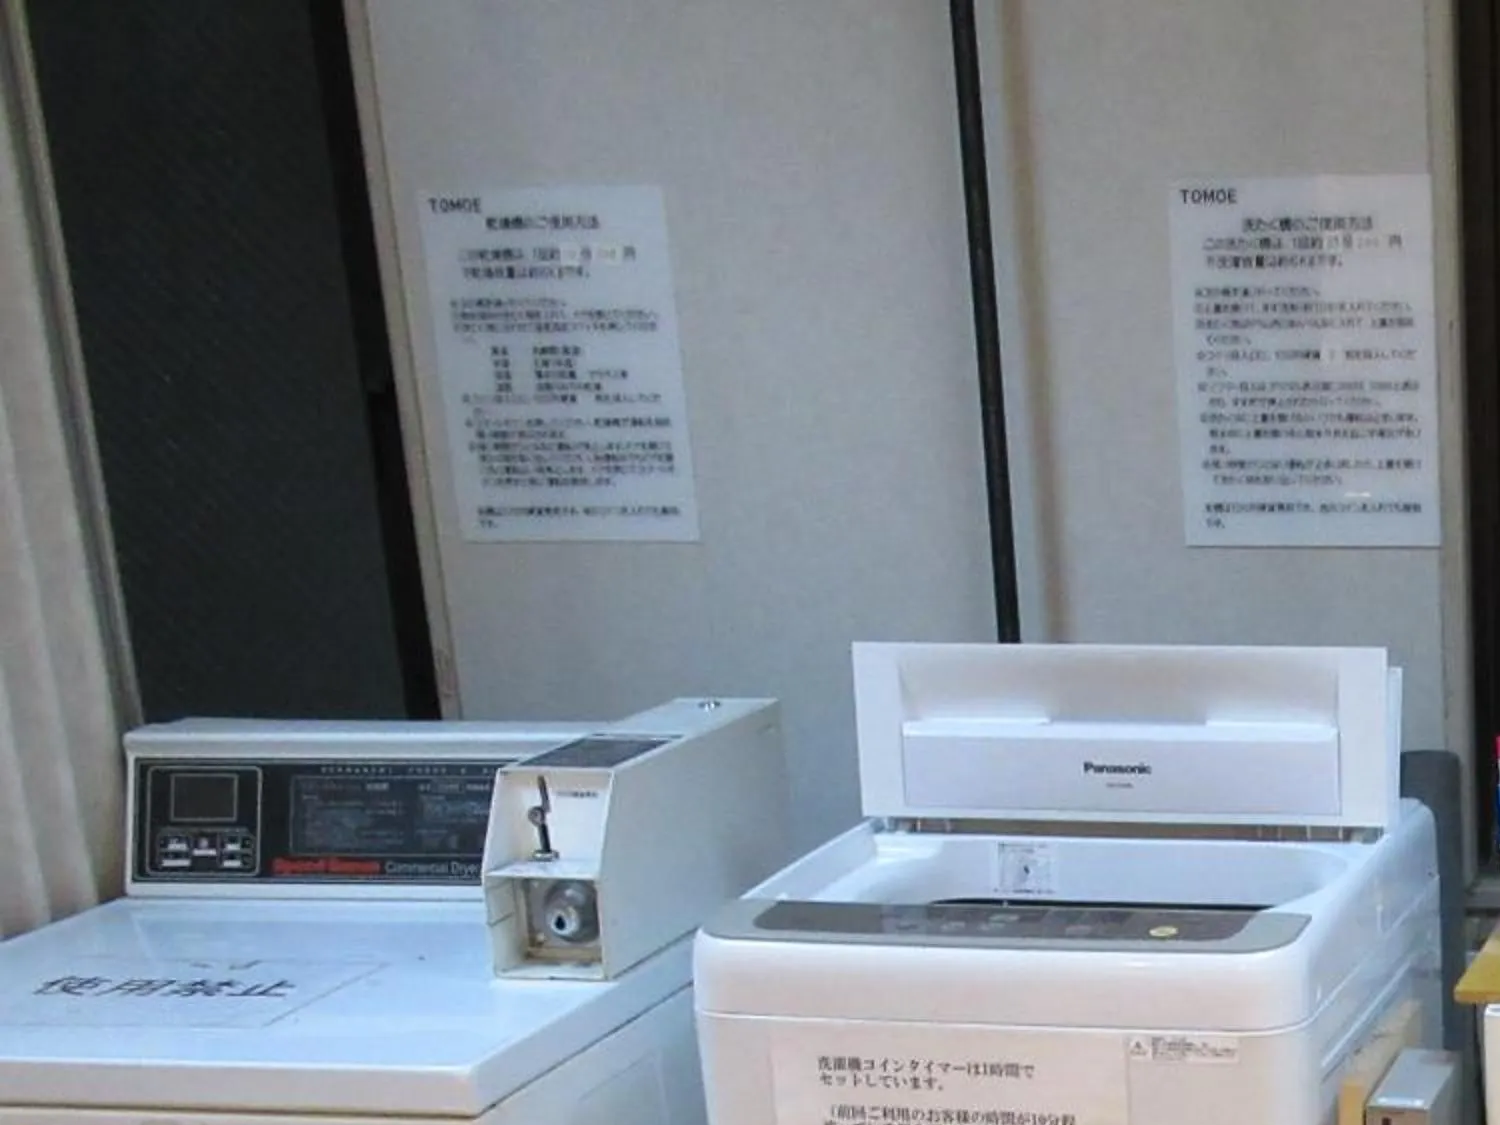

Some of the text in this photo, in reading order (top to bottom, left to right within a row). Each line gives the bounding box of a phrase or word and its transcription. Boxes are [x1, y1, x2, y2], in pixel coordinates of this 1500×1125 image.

[1180, 189, 1238, 204] TOMOE
[428, 198, 482, 213] TOMOE
[1084, 761, 1152, 774] Panasonic
[818, 1055, 1035, 1080] 洗濯機コインタイマーは1時間で
[820, 1074, 944, 1092] セットしています。
